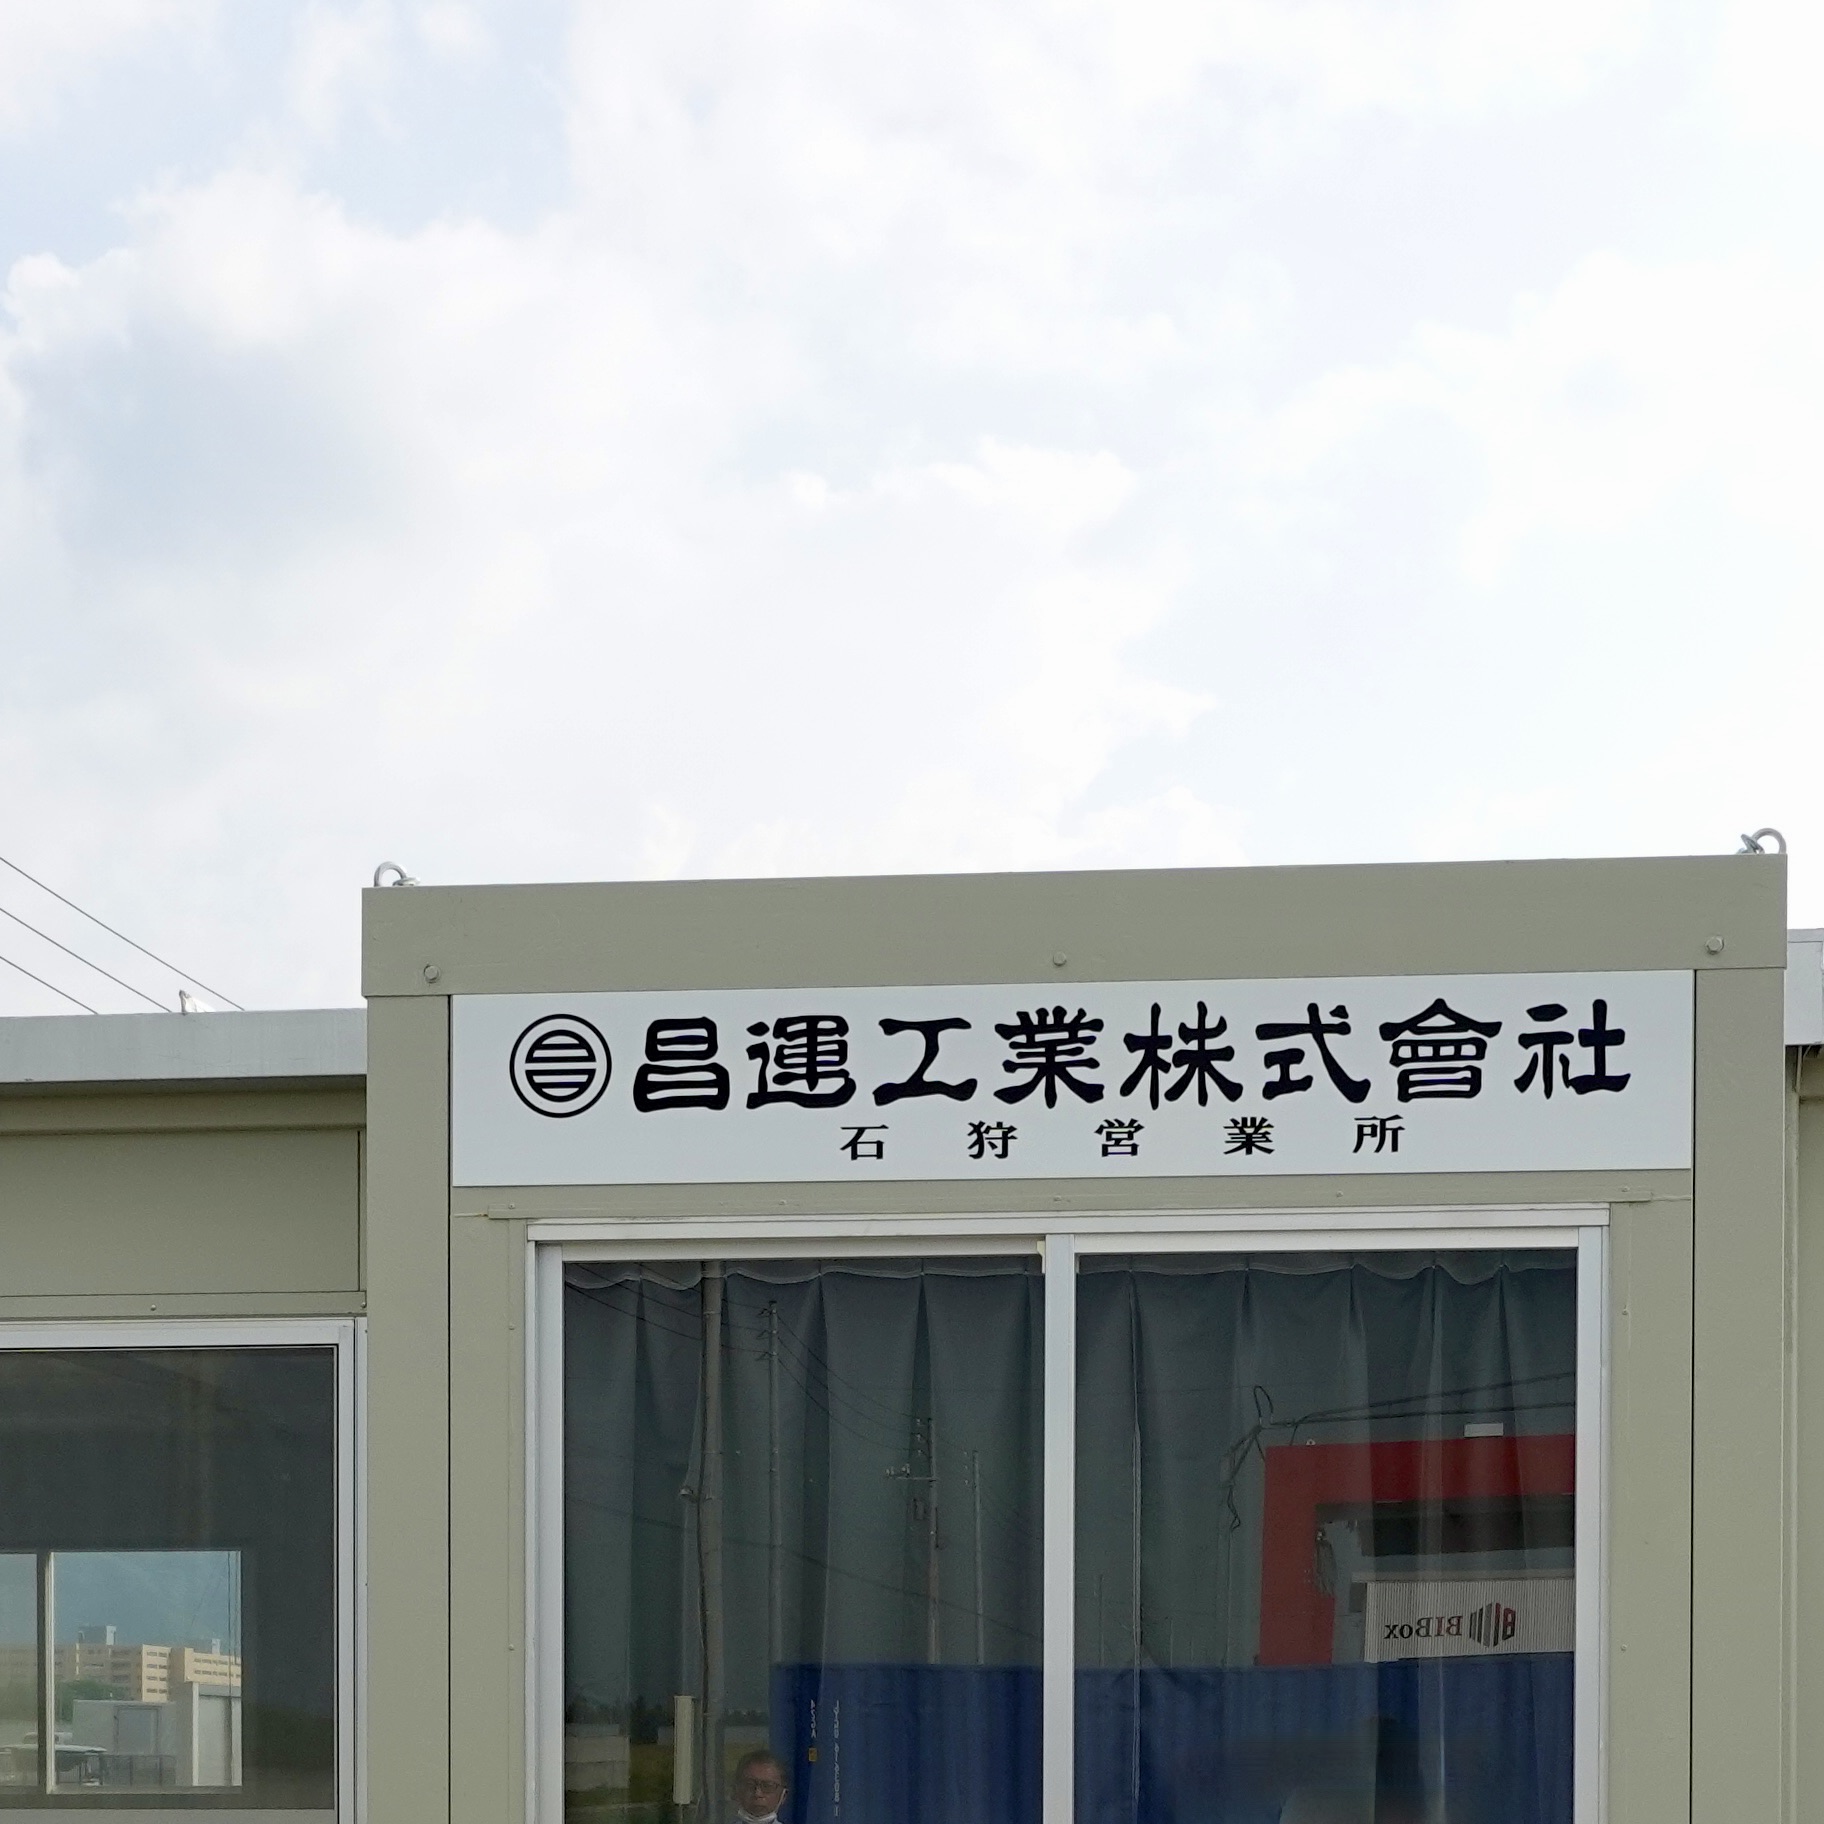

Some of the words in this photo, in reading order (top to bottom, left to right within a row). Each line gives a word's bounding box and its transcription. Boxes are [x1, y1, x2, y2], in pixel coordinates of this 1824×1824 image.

[633, 999, 1630, 1112] 昌運工業株式會社
[840, 1115, 1405, 1161] 石狩営業所
